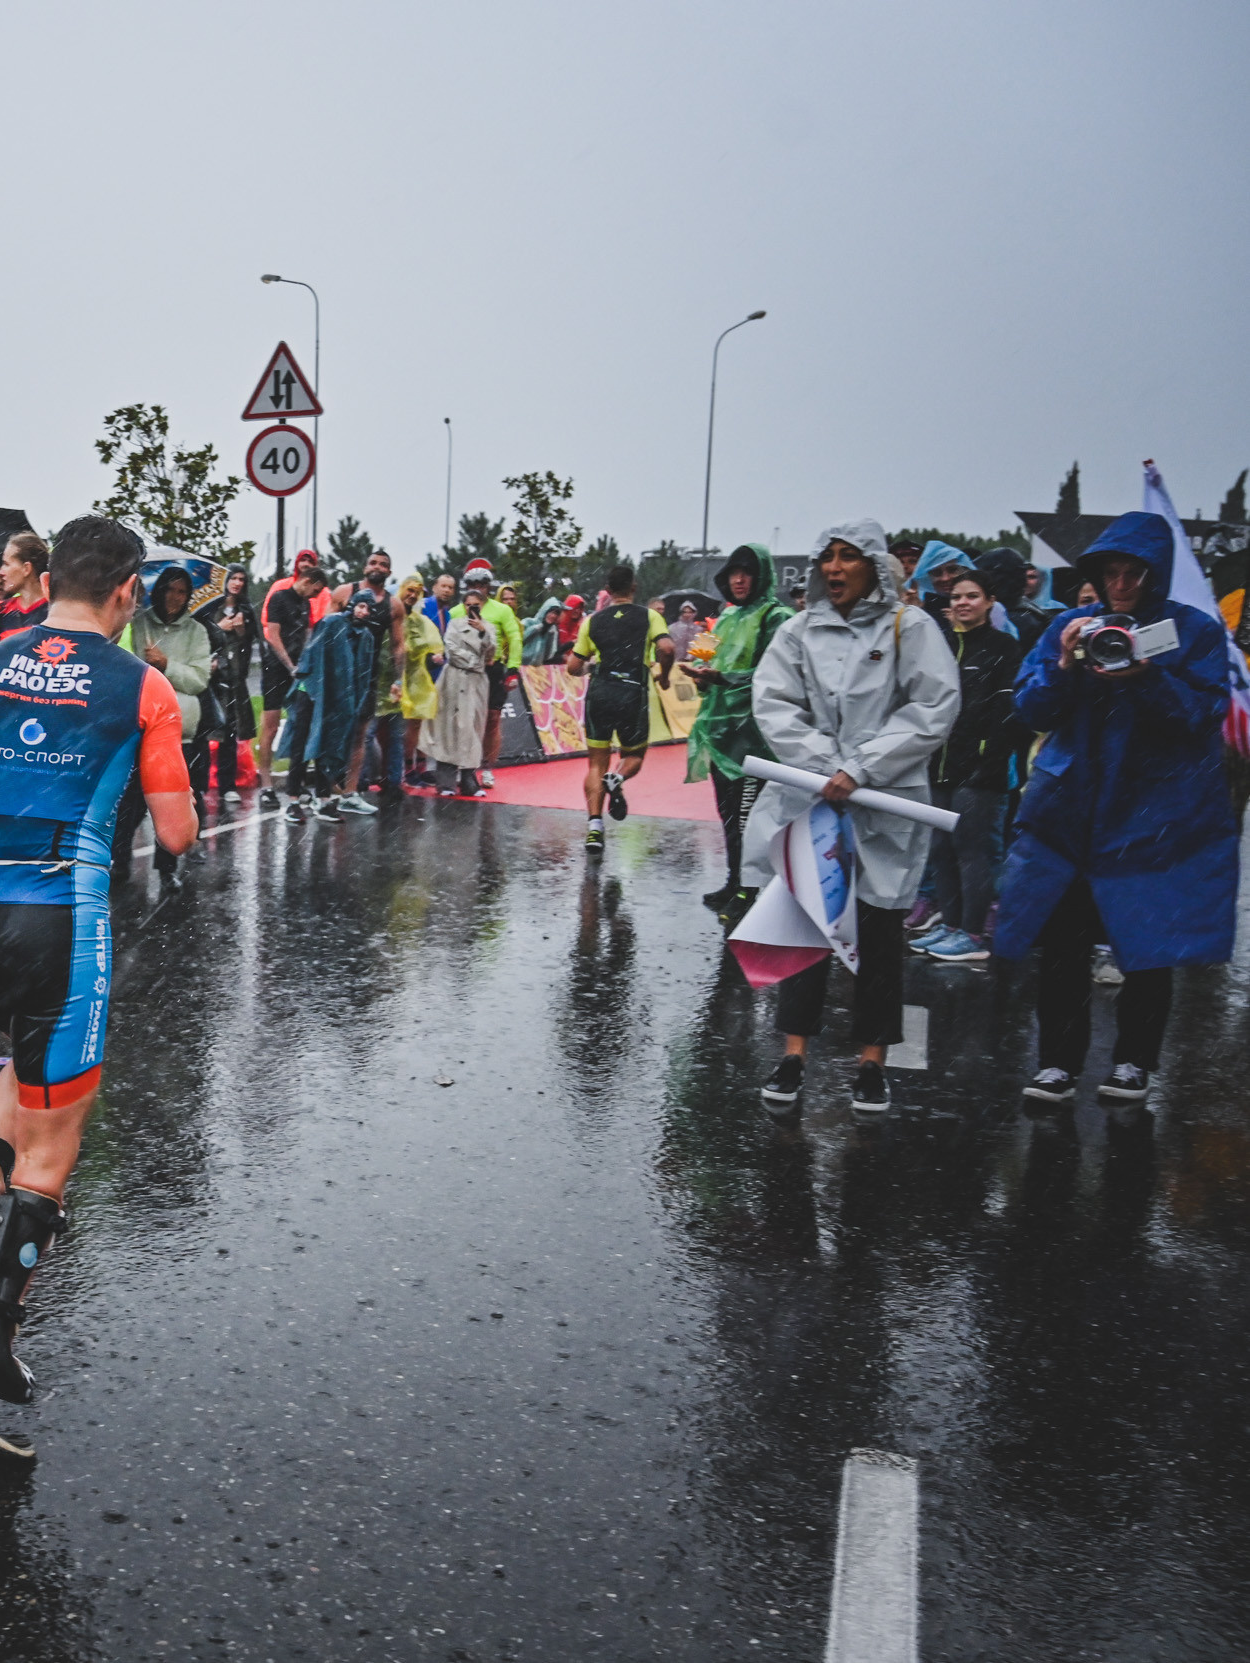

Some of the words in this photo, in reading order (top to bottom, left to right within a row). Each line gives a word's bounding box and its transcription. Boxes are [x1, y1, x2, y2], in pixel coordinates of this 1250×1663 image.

[260, 447, 300, 474] 40
[8, 654, 90, 678] ИНТЕР
[33, 696, 50, 704] без
[95, 919, 106, 973] ИНТЕР
